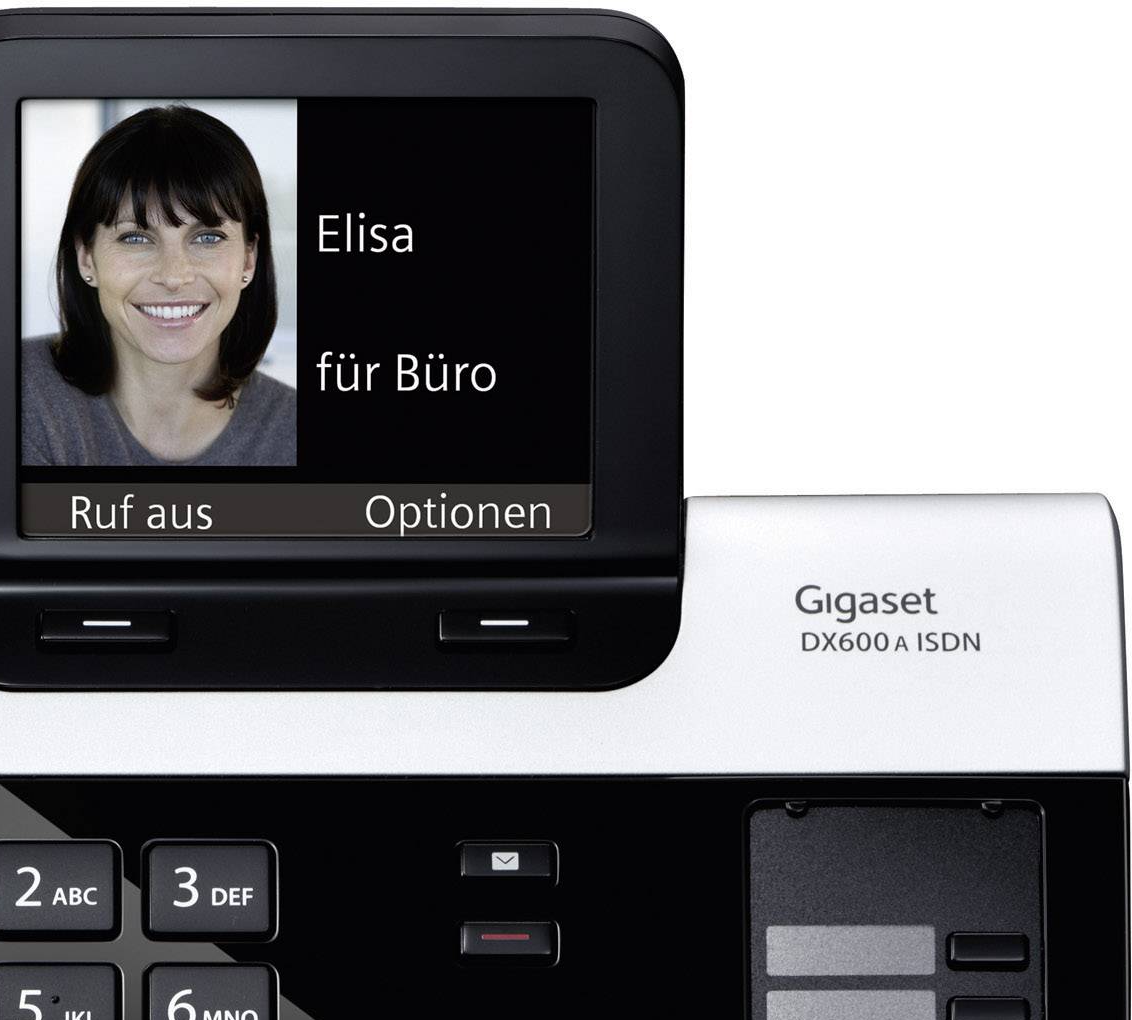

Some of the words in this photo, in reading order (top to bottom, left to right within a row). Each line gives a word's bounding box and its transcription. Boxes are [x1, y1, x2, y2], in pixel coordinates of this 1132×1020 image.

[318, 212, 413, 253] Elisa
[316, 351, 381, 392] für
[397, 353, 497, 392] Büro
[71, 493, 135, 529] Ruf
[147, 504, 213, 530] aus
[365, 492, 551, 537] Optionen
[795, 584, 939, 623] Gigaset
[917, 631, 981, 652] ISDN
[15, 866, 42, 907] 2
[52, 887, 98, 906] ABC
[173, 866, 199, 908] 3
[211, 887, 254, 906] DEF
